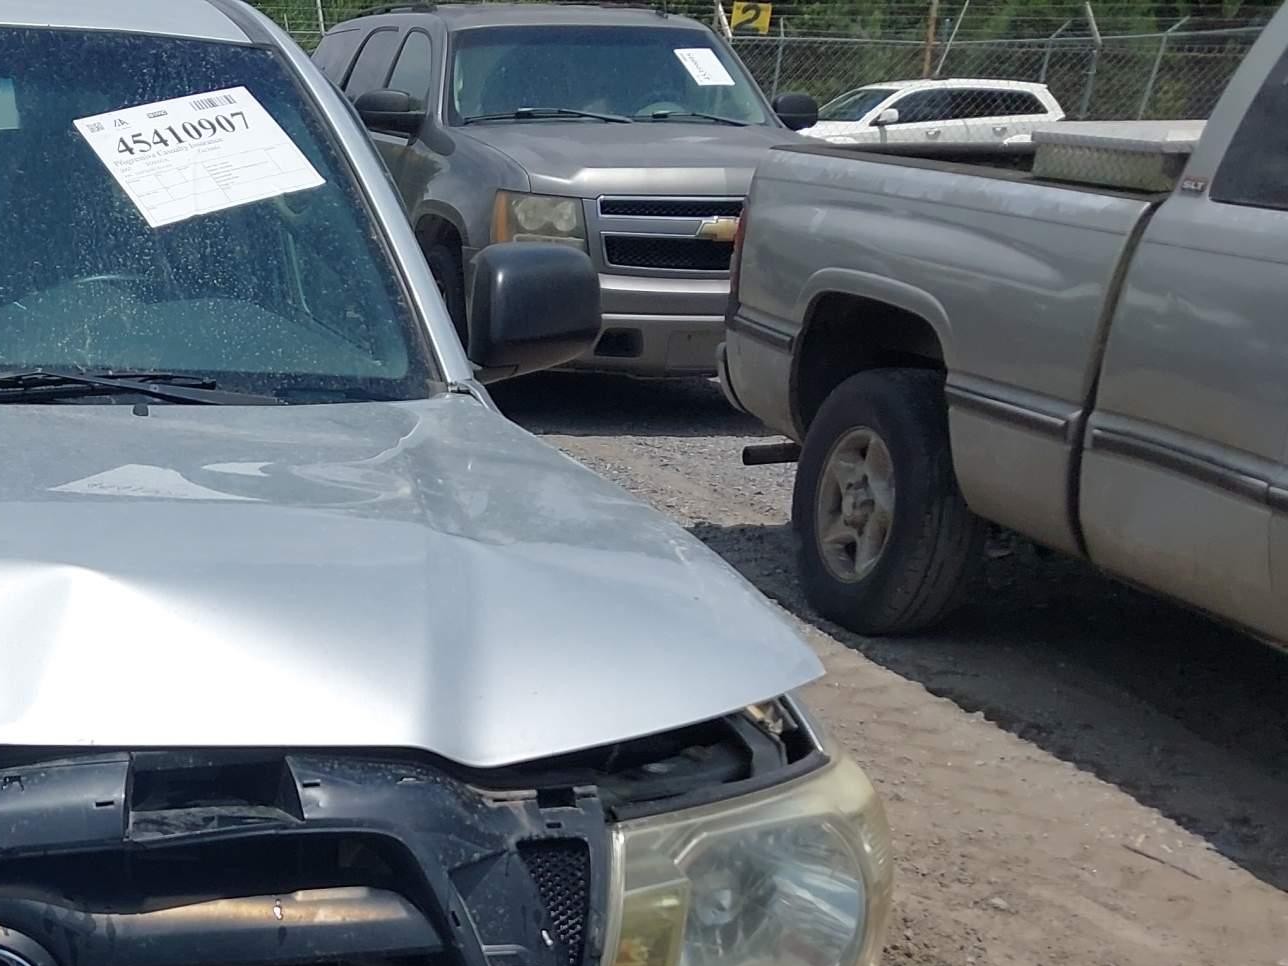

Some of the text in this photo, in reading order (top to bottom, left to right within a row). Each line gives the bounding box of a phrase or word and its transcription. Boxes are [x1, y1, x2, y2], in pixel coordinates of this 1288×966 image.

[733, 4, 760, 32] 2
[117, 111, 250, 155] 45410907
[1183, 181, 1205, 190] SLT
